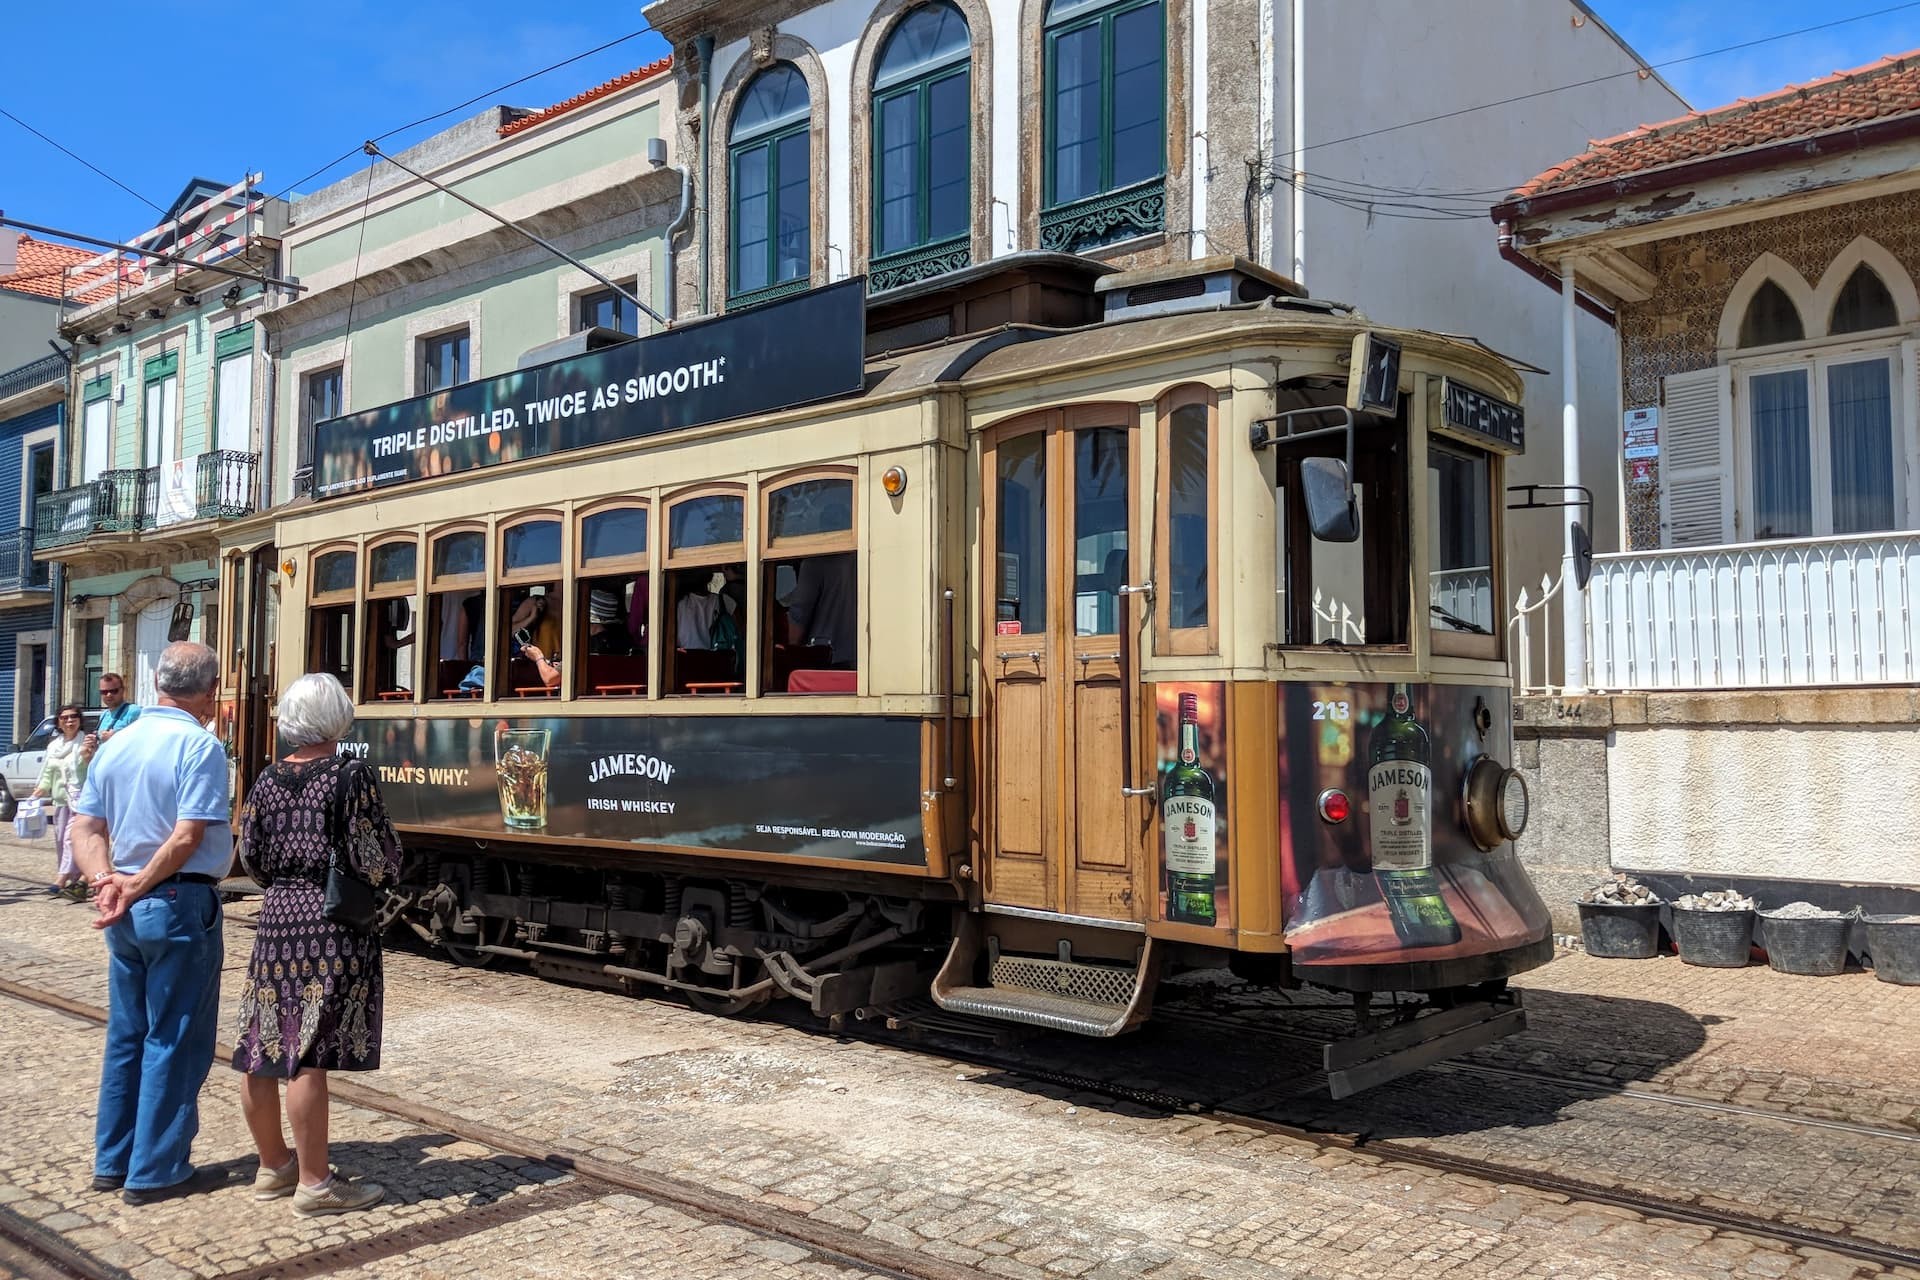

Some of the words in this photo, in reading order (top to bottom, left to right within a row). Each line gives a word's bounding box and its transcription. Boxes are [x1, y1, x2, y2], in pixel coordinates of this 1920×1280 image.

[1380, 351, 1389, 402] 1
[372, 428, 426, 458] TRIPLE
[430, 407, 519, 446] DISTILLED.
[525, 390, 587, 425] TWICE
[592, 383, 619, 411] AS
[1312, 701, 1349, 720] 213
[335, 742, 370, 759] WHY?
[378, 766, 426, 785] THAT'S
[588, 753, 673, 785] JAMESON
[1371, 768, 1429, 792] JAMESON
[587, 798, 618, 811] IRISH
[621, 799, 676, 815] WHISKEY
[1166, 801, 1212, 820] JAMESON
[756, 825, 772, 833] SEJA
[822, 829, 840, 838] BEBA
[841, 831, 857, 839] COM
[859, 832, 906, 842] MODERAÇÃO.
